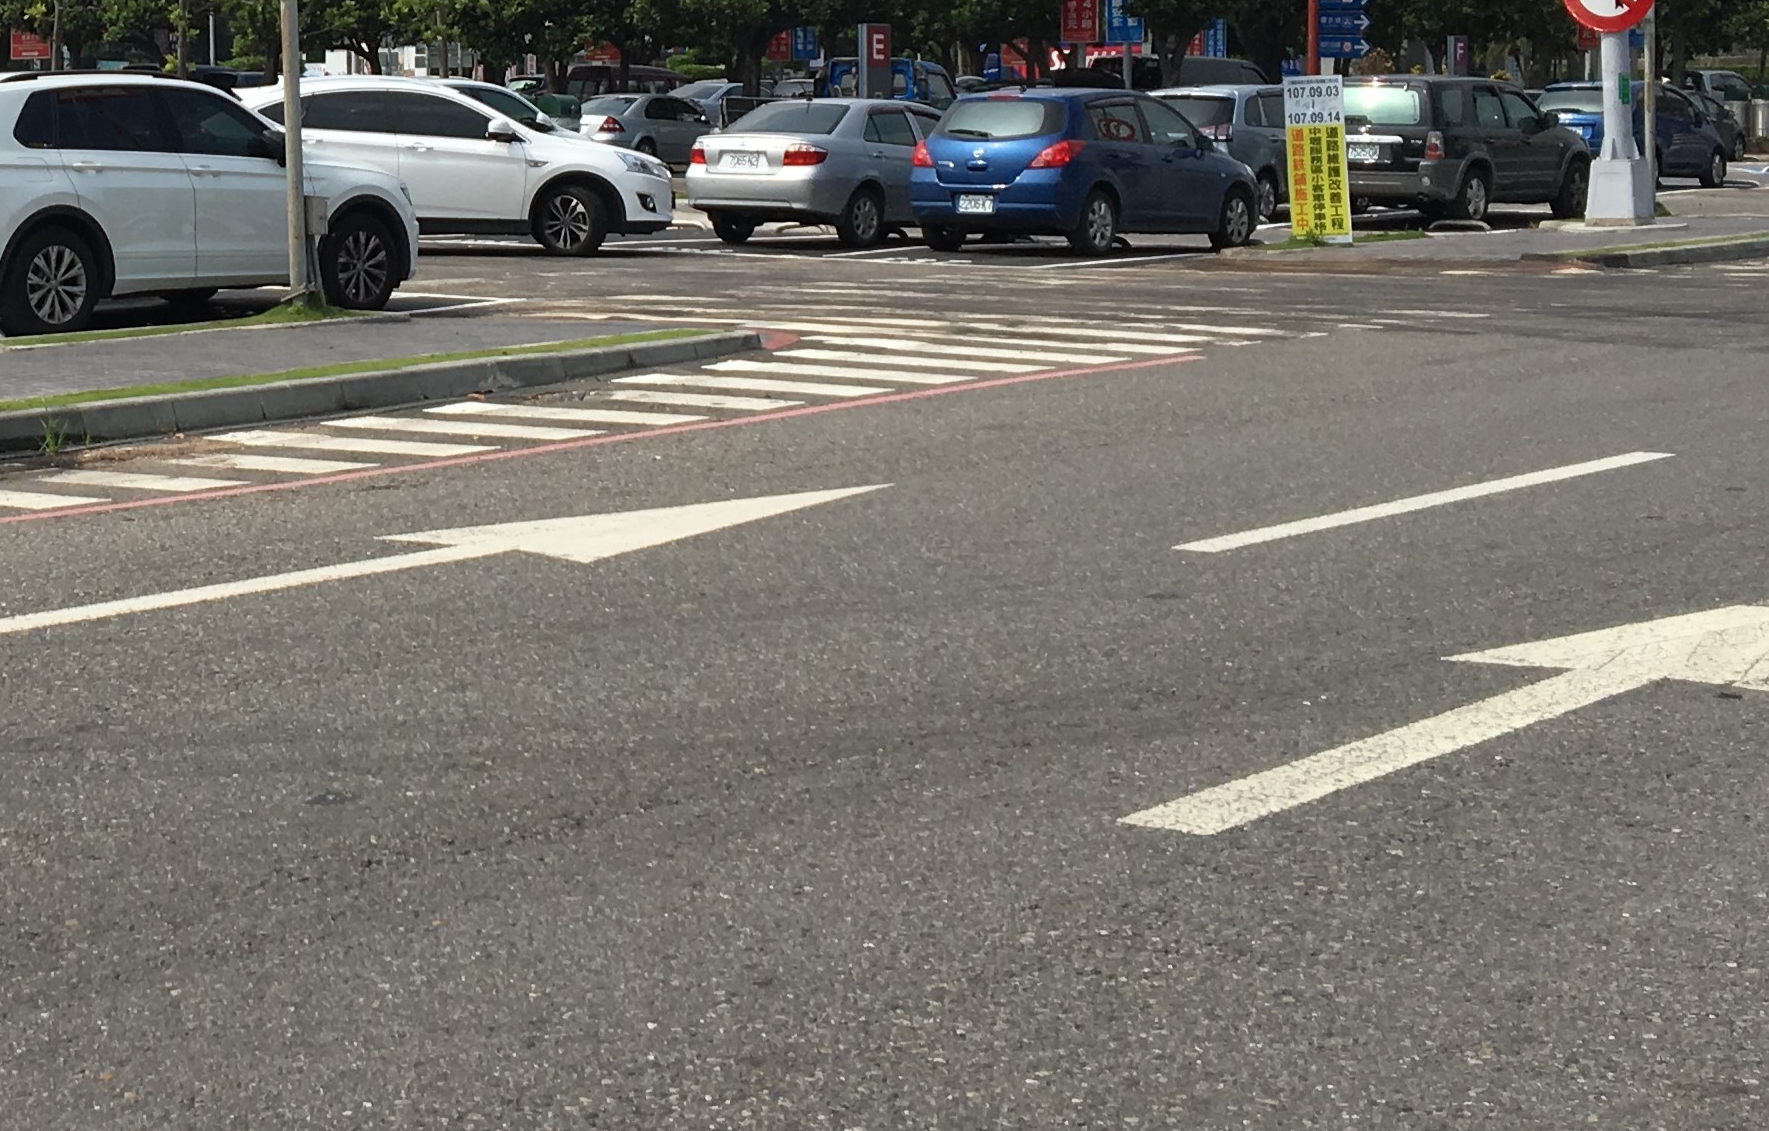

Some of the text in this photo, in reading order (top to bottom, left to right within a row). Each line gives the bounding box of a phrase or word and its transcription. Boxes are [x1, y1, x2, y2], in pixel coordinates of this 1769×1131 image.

[873, 33, 885, 60] E
[1456, 42, 1465, 62] F
[1287, 85, 1339, 98] 107.09.03
[1288, 111, 1341, 124] 107.09.14
[1326, 127, 1344, 230] 道路維護改善工程
